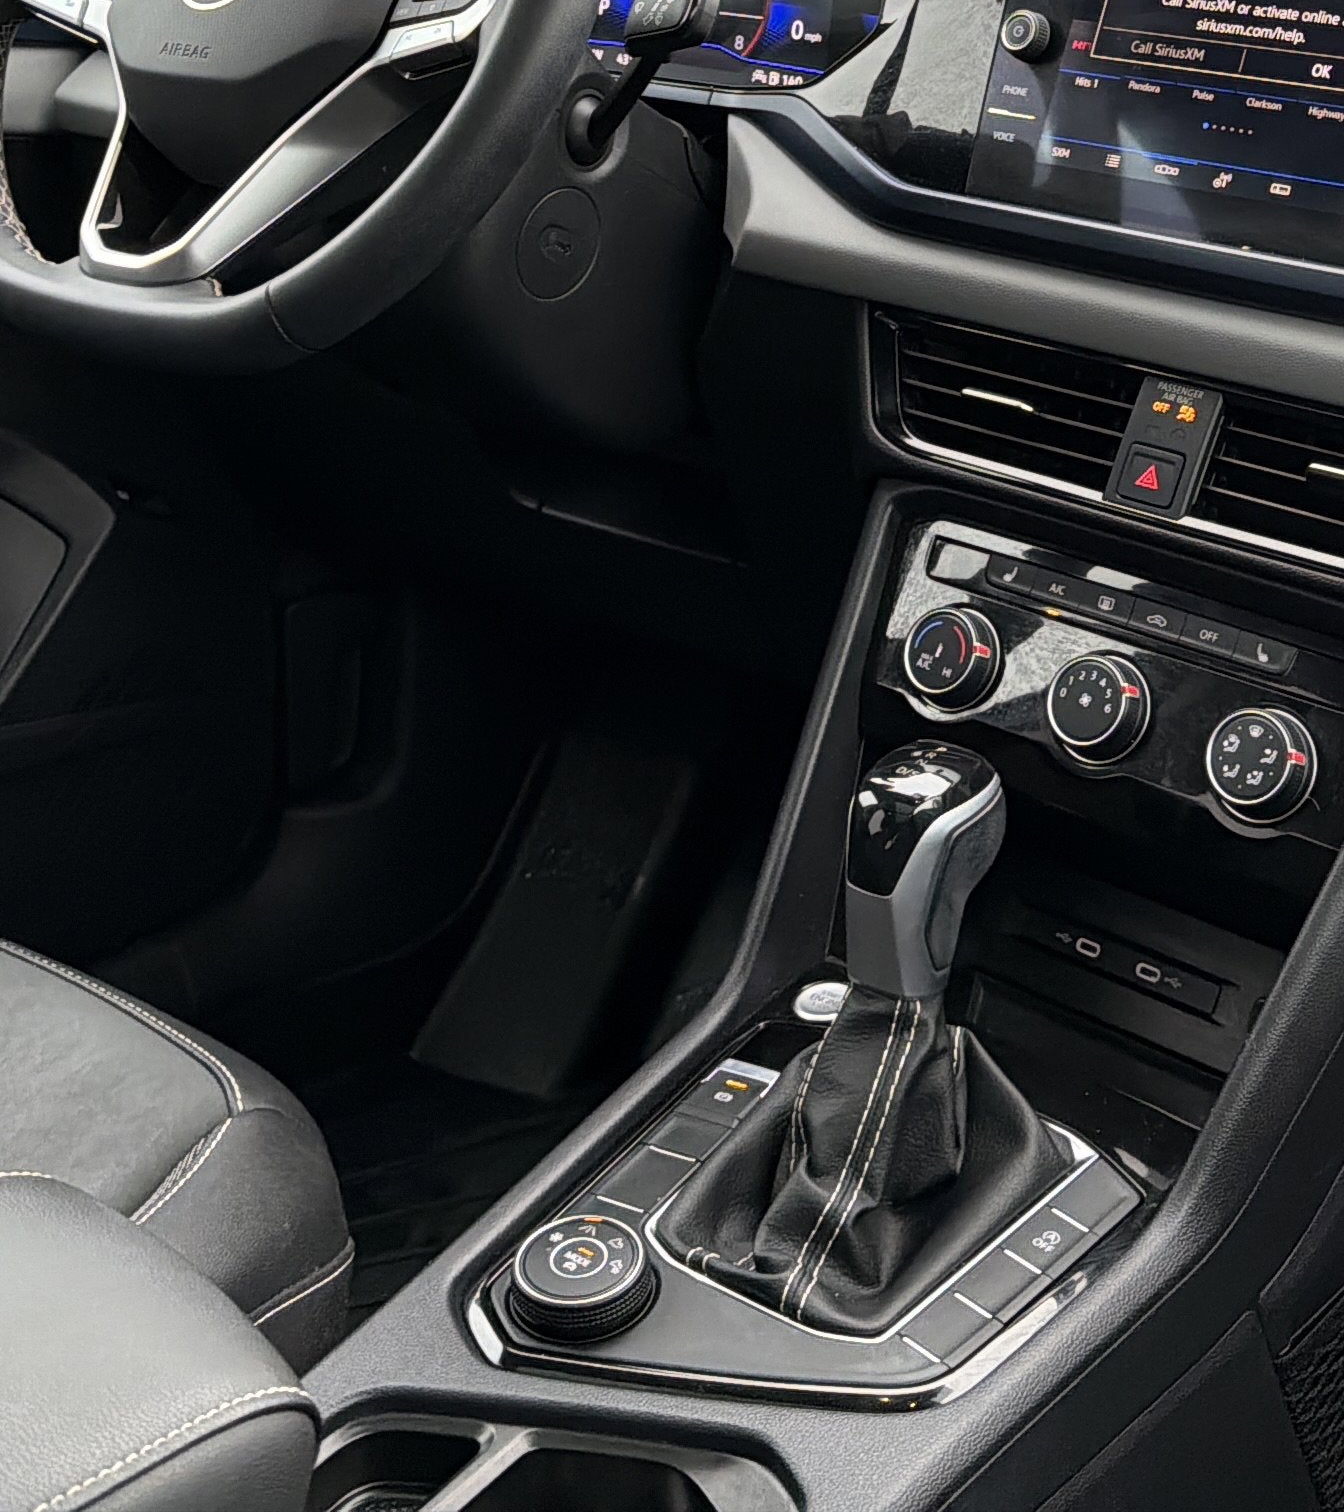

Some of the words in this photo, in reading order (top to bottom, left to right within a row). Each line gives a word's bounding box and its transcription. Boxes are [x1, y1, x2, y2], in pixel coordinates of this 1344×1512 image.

[1237, 4, 1252, 16] or
[1253, 5, 1300, 22] activate
[1301, 10, 1341, 26] online
[791, 19, 804, 40] 0
[1196, 18, 1306, 46] siriusxm.com/help.
[734, 35, 745, 50] 8
[159, 42, 212, 59] AIRBAG
[1130, 40, 1153, 55] Call
[1154, 44, 1206, 62] SiriusXM
[1311, 63, 1334, 80] OK
[1075, 76, 1092, 88] Hits
[1093, 79, 1099, 88] 1
[1128, 80, 1161, 94] Pandora
[1002, 84, 1028, 97] PHONE
[1192, 89, 1215, 102] Pulse
[1246, 97, 1283, 112] Clarkson
[992, 131, 1016, 143] VOICE
[1051, 146, 1071, 159] SXM
[1157, 381, 1205, 399] PASSENGER
[1048, 583, 1067, 596] A/C
[1199, 629, 1220, 643] OFF
[1068, 675, 1075, 686] 1
[1078, 670, 1086, 681] 2
[1090, 670, 1098, 681] 3
[1099, 677, 1107, 688] 4
[1060, 687, 1067, 698] 0
[1105, 688, 1112, 699] 5
[1104, 703, 1112, 714] 6
